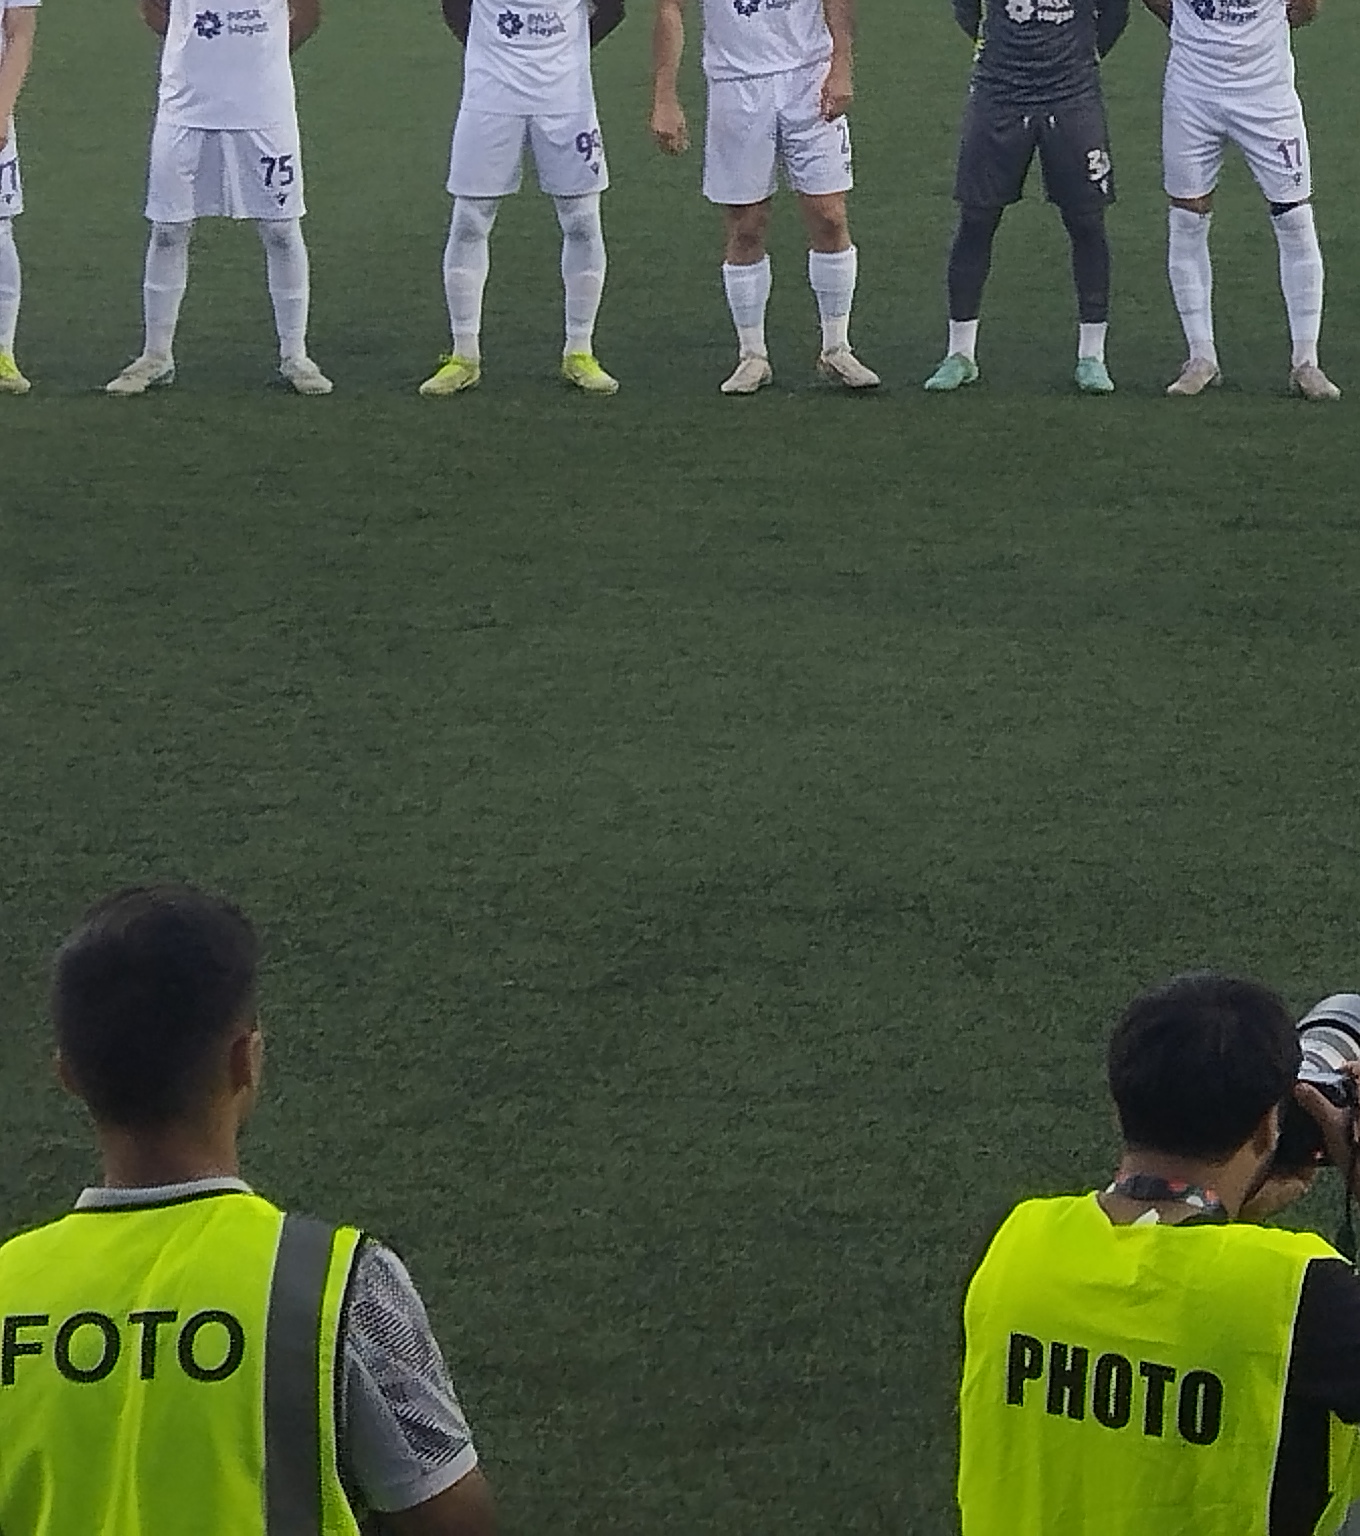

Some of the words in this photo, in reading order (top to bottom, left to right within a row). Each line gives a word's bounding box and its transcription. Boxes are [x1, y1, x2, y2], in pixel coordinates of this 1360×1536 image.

[260, 154, 294, 187] 75
[1, 1308, 246, 1386] FOTO
[1006, 1331, 1224, 1446] PHOTO
